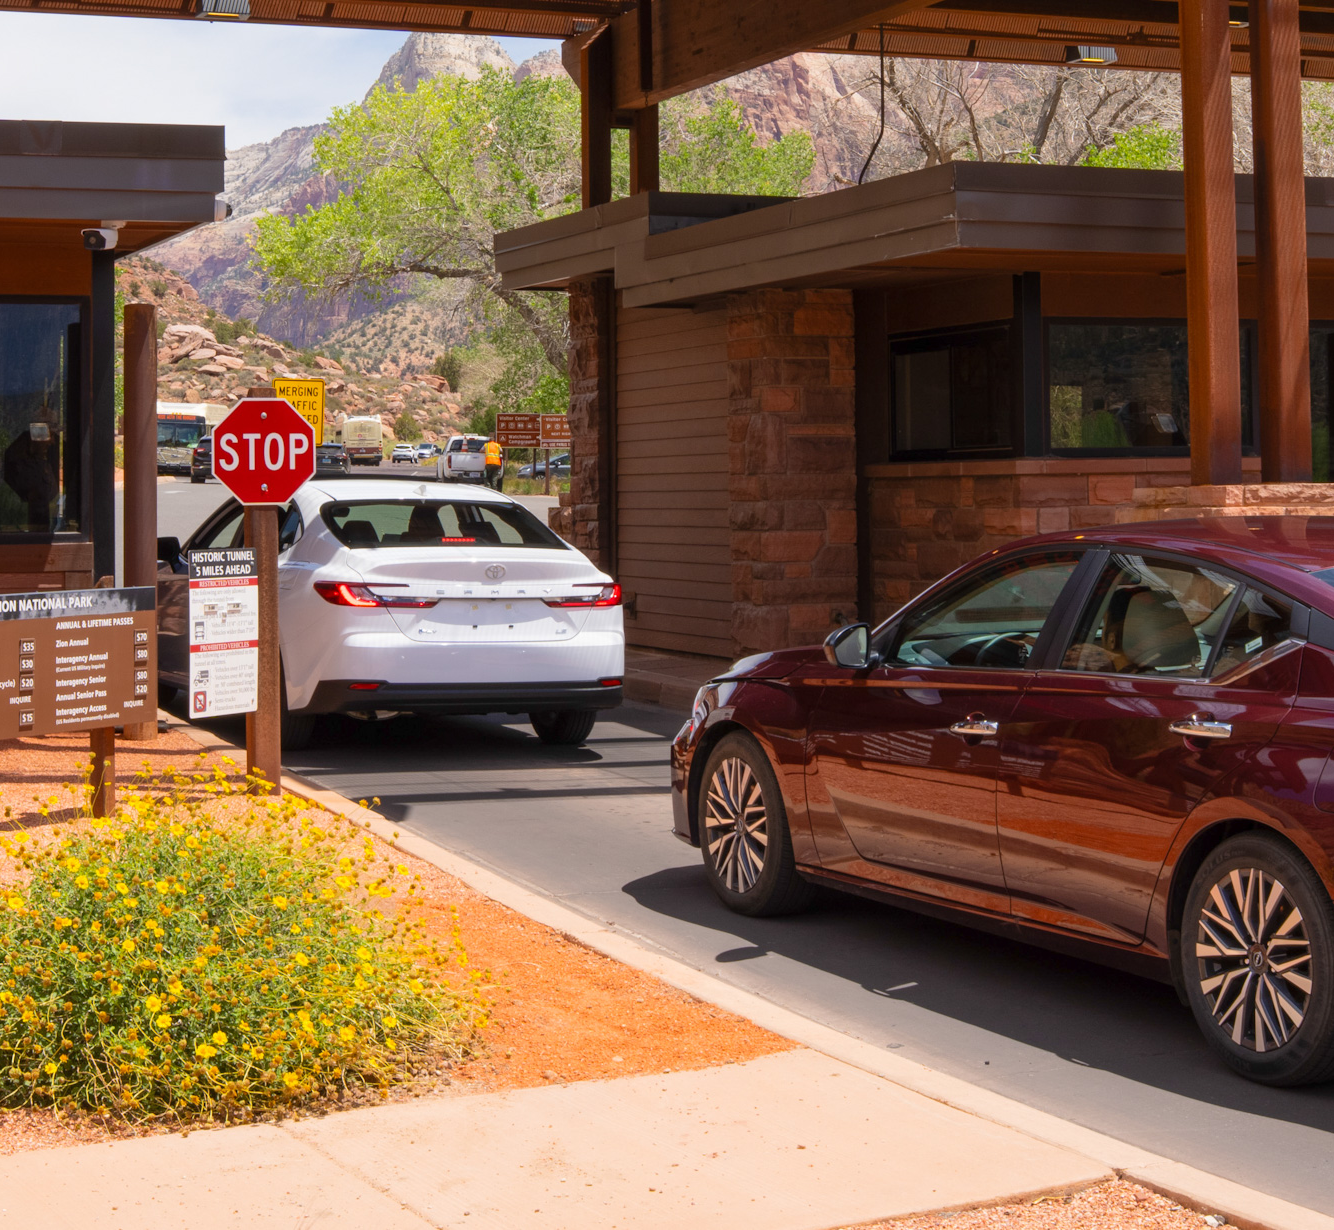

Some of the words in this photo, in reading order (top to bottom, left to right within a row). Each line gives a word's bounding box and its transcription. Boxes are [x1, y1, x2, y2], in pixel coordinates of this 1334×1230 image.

[279, 387, 319, 397] MERGING
[291, 401, 317, 411] AFFIC
[219, 432, 309, 472] STOP
[191, 551, 226, 563] HISTORIC
[226, 550, 255, 562] TUNNEL
[196, 567, 201, 577] 5
[202, 565, 224, 576] MILES
[225, 564, 251, 575] AHEAD
[199, 580, 228, 588] RESTRICTED
[227, 578, 250, 586] VEHICLES
[19, 597, 67, 612] NATIONAL
[68, 596, 93, 608] PARK
[56, 621, 82, 630] ANNUAL
[82, 620, 87, 629] &
[87, 618, 112, 628] LIFETIME
[113, 617, 134, 626] PASSES
[136, 632, 148, 642] $70
[22, 642, 35, 652] $35
[55, 639, 68, 648] Zion
[69, 637, 89, 647] Annual
[200, 644, 228, 652] PROHIBITED
[227, 641, 250, 649] VEHICLES
[55, 654, 88, 665] Interagency
[89, 652, 109, 662] Annual
[137, 649, 148, 659] $80
[21, 659, 34, 669] $30
[136, 670, 148, 680] $80
[21, 678, 34, 687] $20
[55, 678, 88, 688] Interagency
[89, 675, 107, 685] Senior
[136, 684, 148, 694] $20
[9, 695, 32, 705] INQUIRE
[56, 692, 76, 702] Annual
[76, 690, 94, 700] Senior
[95, 689, 107, 698] Pass
[123, 699, 144, 709] INQUIRE
[55, 706, 88, 717] Interagency
[89, 704, 107, 713] Access
[22, 713, 33, 723] $15
